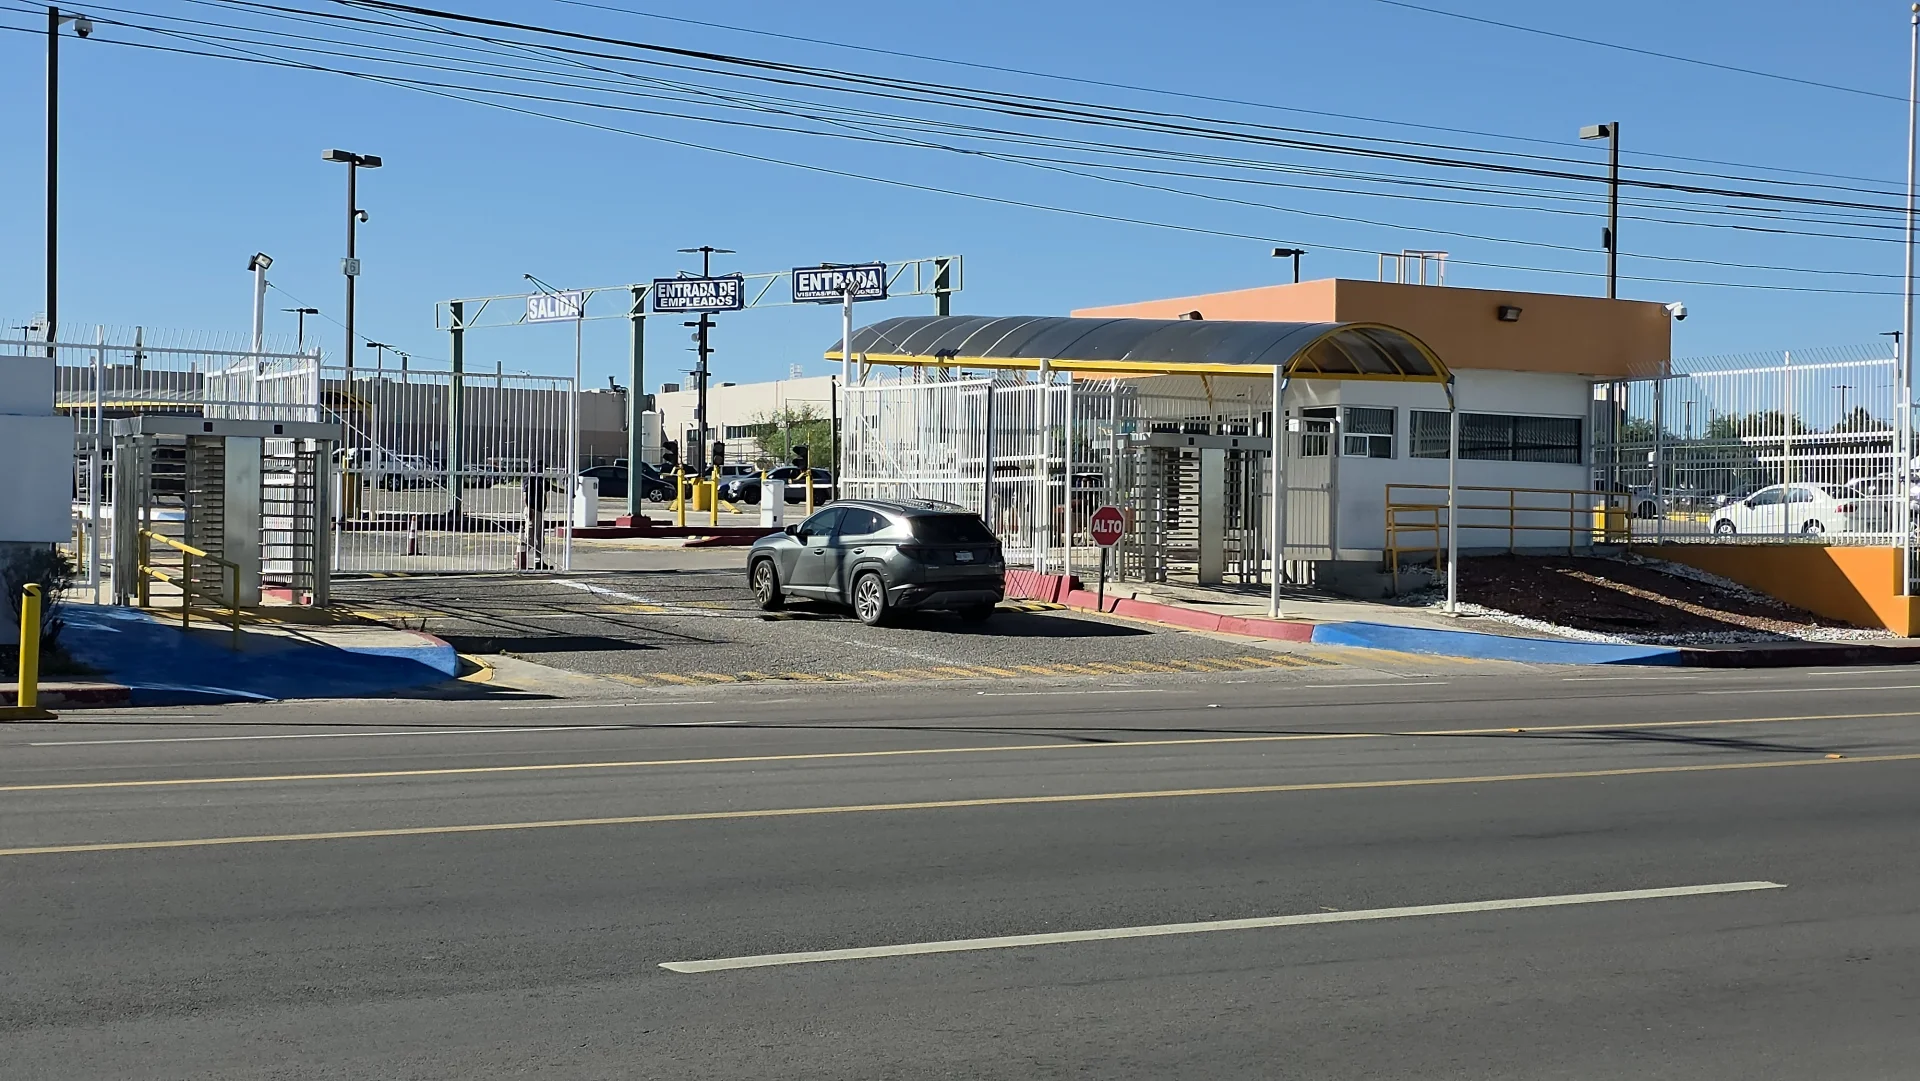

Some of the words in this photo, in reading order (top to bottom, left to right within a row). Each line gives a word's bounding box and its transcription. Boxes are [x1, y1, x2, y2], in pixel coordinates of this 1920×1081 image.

[799, 270, 879, 292] ENTRADA
[657, 282, 717, 298] ENTRADA
[719, 282, 736, 296] DE
[529, 295, 579, 319] SALIDA
[660, 296, 733, 307] EMPLEADOS
[1092, 518, 1123, 534] ALTO
